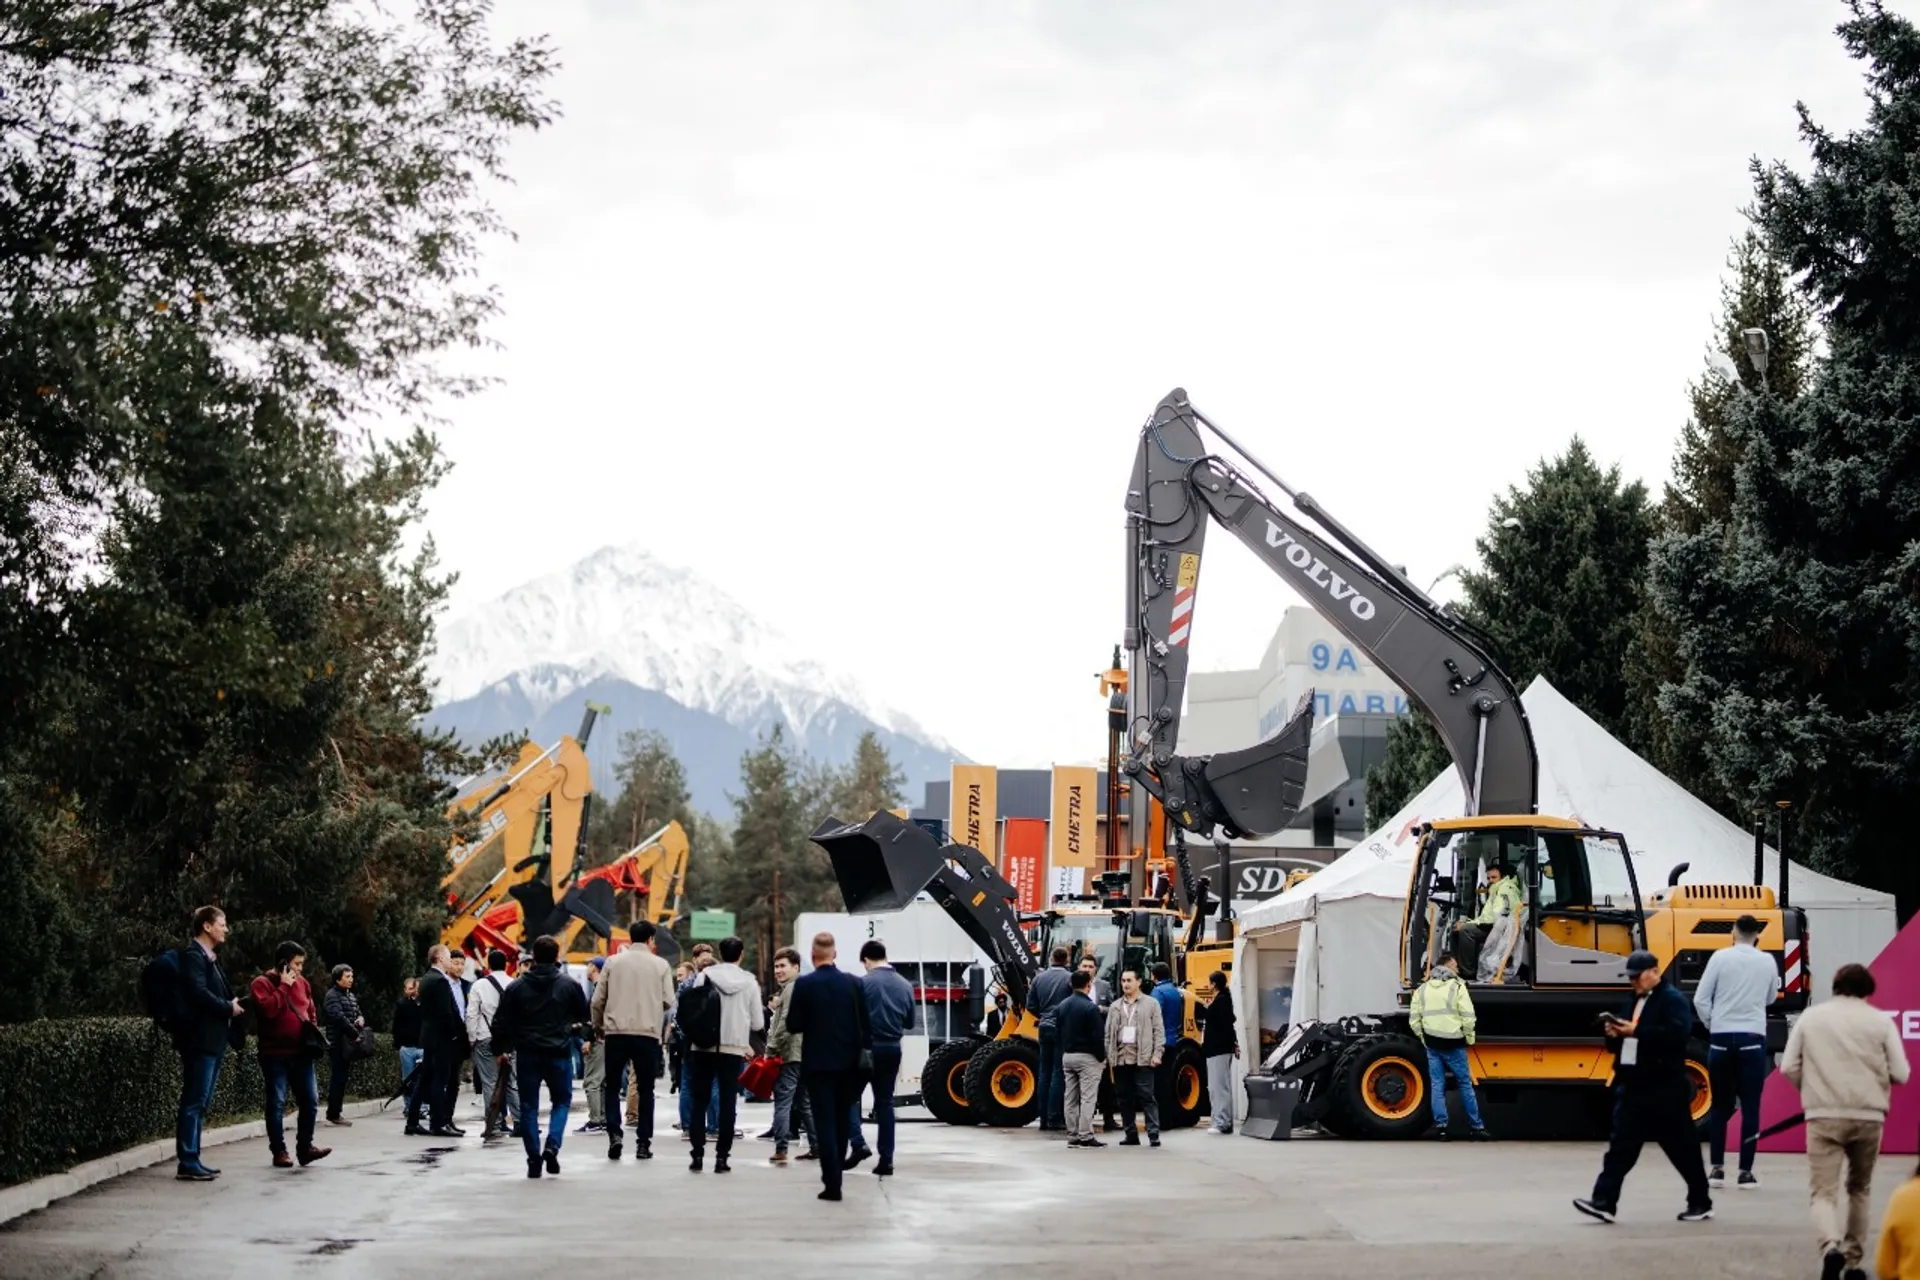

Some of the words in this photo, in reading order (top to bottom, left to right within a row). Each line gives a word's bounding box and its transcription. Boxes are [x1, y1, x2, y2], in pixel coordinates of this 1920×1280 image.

[1266, 519, 1375, 620] VOLVO
[1068, 786, 1081, 854] CHETRA
[1237, 867, 1308, 893] SD
[1002, 919, 1029, 964] VOLVO
